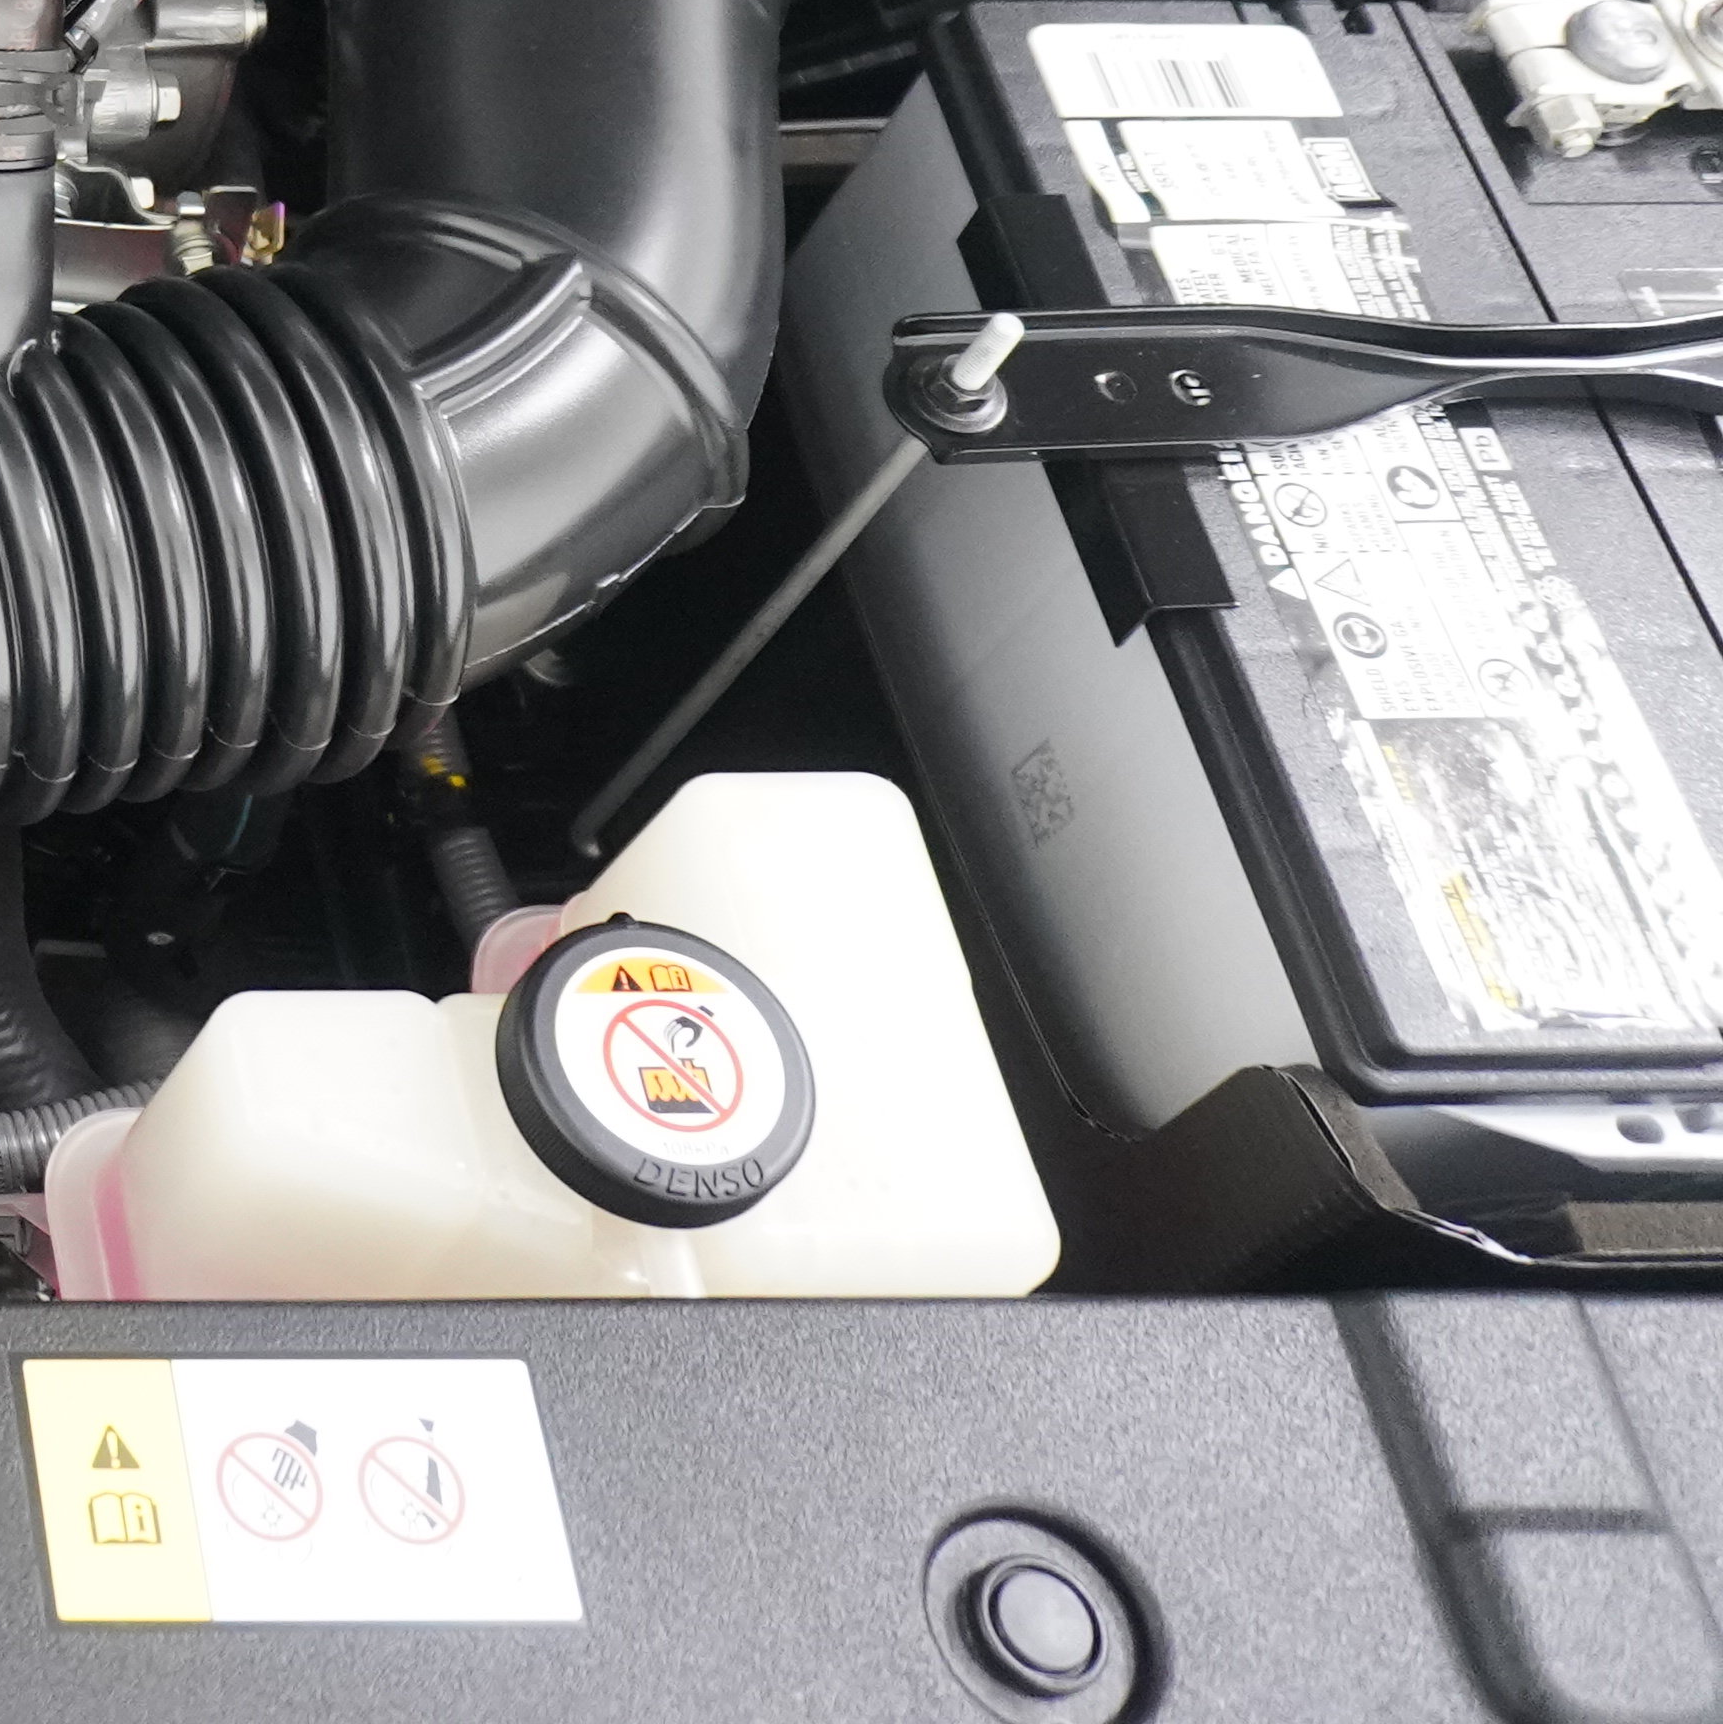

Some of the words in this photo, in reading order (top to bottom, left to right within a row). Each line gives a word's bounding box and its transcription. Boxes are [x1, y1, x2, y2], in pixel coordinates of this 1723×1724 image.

[1475, 435, 1501, 462] Pb
[1363, 668, 1398, 711] SHIELD
[1391, 680, 1421, 711] EYES
[1397, 644, 1444, 711] EXPLOSIVE
[632, 1155, 765, 1200] DENSO
